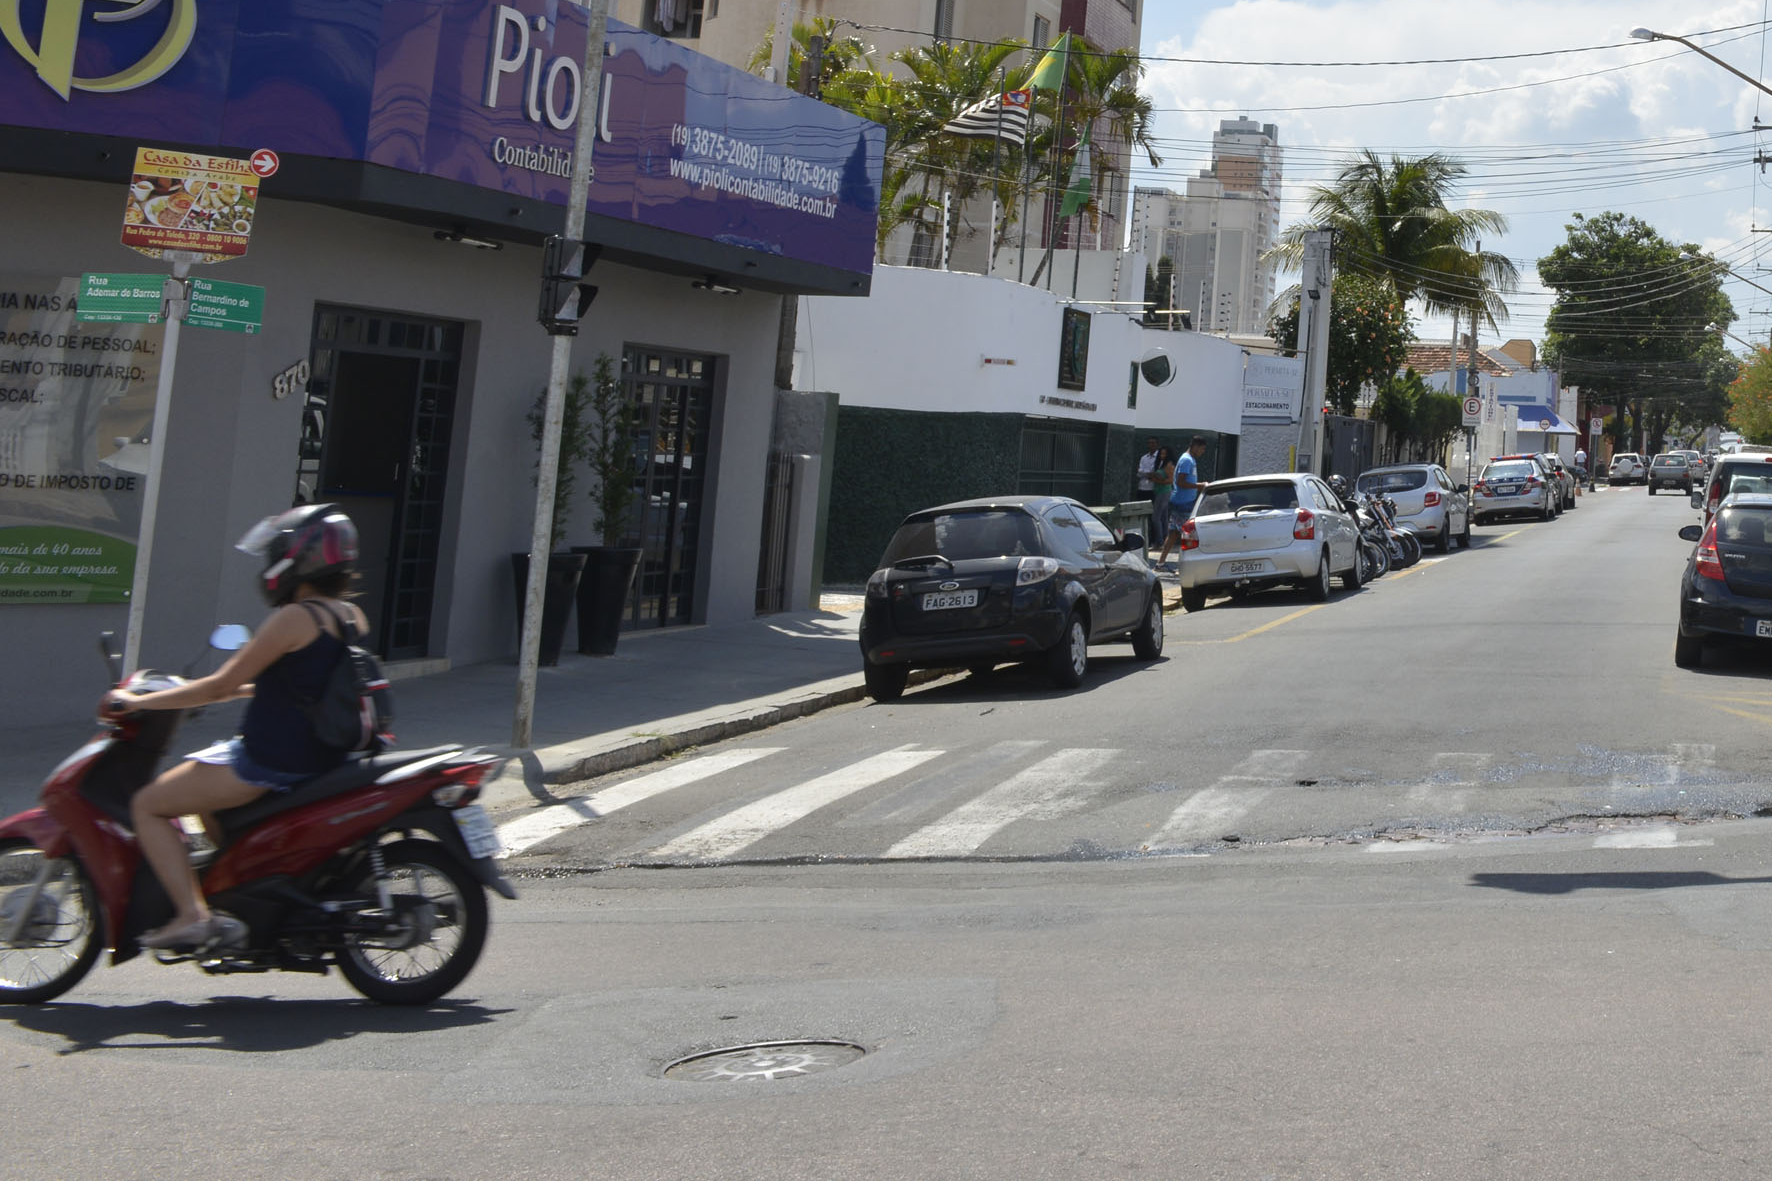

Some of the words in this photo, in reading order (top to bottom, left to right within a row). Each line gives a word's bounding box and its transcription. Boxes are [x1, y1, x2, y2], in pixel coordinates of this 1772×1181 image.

[487, 4, 617, 143] Pioi
[144, 150, 178, 164] Casa
[183, 157, 202, 167] da
[494, 137, 595, 183] Contabilide
[671, 123, 691, 150] (19)
[692, 127, 758, 171] 3875-2089
[765, 153, 782, 176] (19)
[782, 155, 839, 194] 3875-9216
[670, 158, 837, 219] www.piolicontabilidade.com.br
[126, 226, 137, 235] Rua
[88, 276, 108, 285] Rua
[194, 280, 212, 291] Rua
[86, 287, 119, 297] Ademar
[120, 288, 131, 298] de
[132, 288, 161, 299] Barros
[192, 291, 238, 307] Bernardino
[239, 299, 250, 308] de
[24, 293, 62, 312] NAS
[190, 303, 227, 317] Campos
[57, 335, 77, 349] DE
[81, 336, 156, 355] PESSOAL;
[49, 362, 146, 382] TRIBUTÁRIO;
[273, 359, 311, 399] 870
[1245, 401, 1290, 410] ESTACIONAMENTO
[14, 475, 36, 488] DE
[40, 475, 110, 490] IMPOSTO
[115, 476, 137, 491] DE
[33, 543, 48, 555] de
[52, 543, 67, 556] 40
[71, 547, 103, 556] anos
[12, 562, 31, 575] da
[34, 566, 58, 575] sua
[62, 566, 119, 577] empresa.
